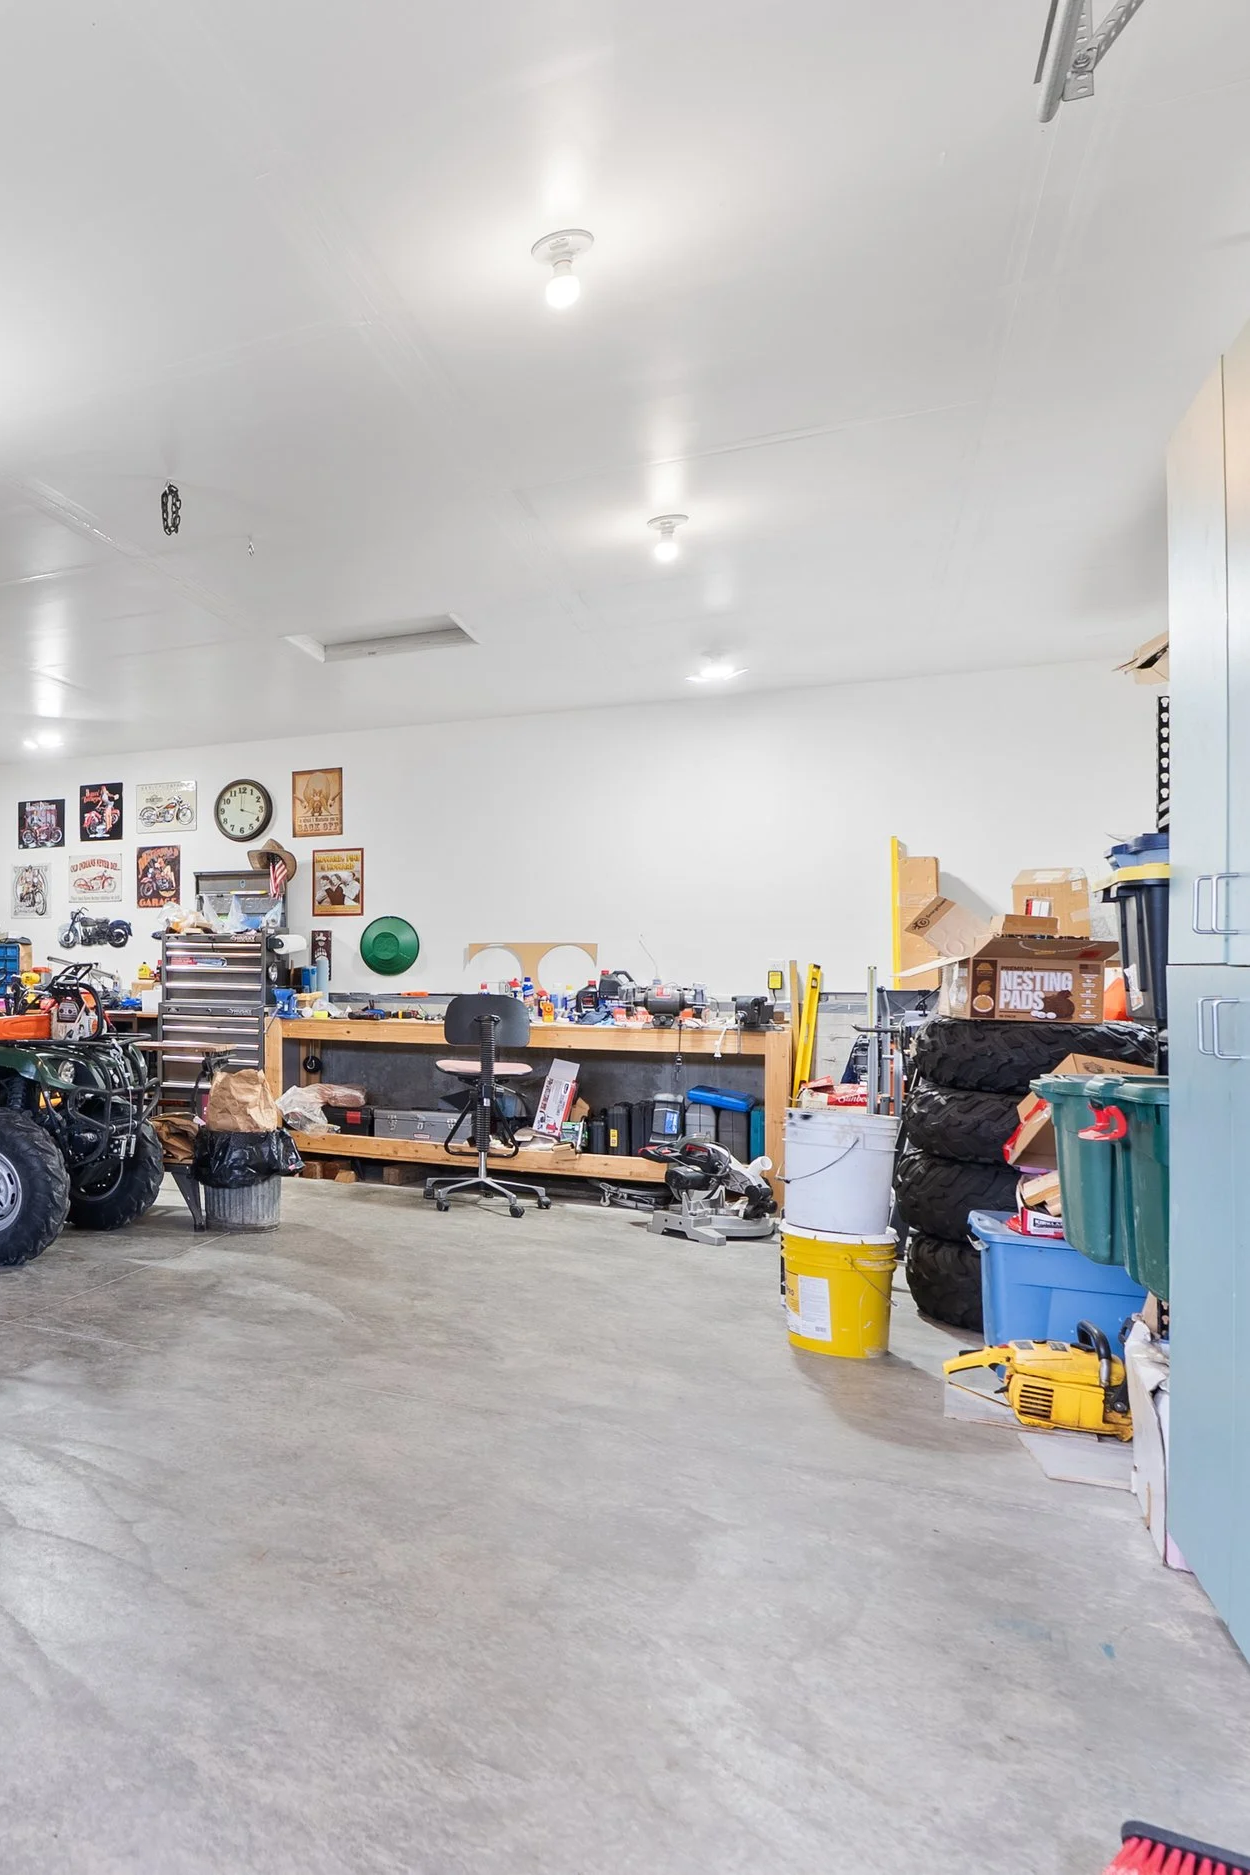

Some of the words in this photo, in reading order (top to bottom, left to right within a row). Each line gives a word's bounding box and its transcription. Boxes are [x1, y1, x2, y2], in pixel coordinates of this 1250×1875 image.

[223, 797, 231, 805] 10
[258, 805, 264, 813] 3
[298, 823, 320, 832] BACK
[323, 822, 339, 831] OFF
[1000, 971, 1073, 992] NESTING
[999, 990, 1046, 1011] PADS
[837, 1094, 867, 1103] Sunbe
